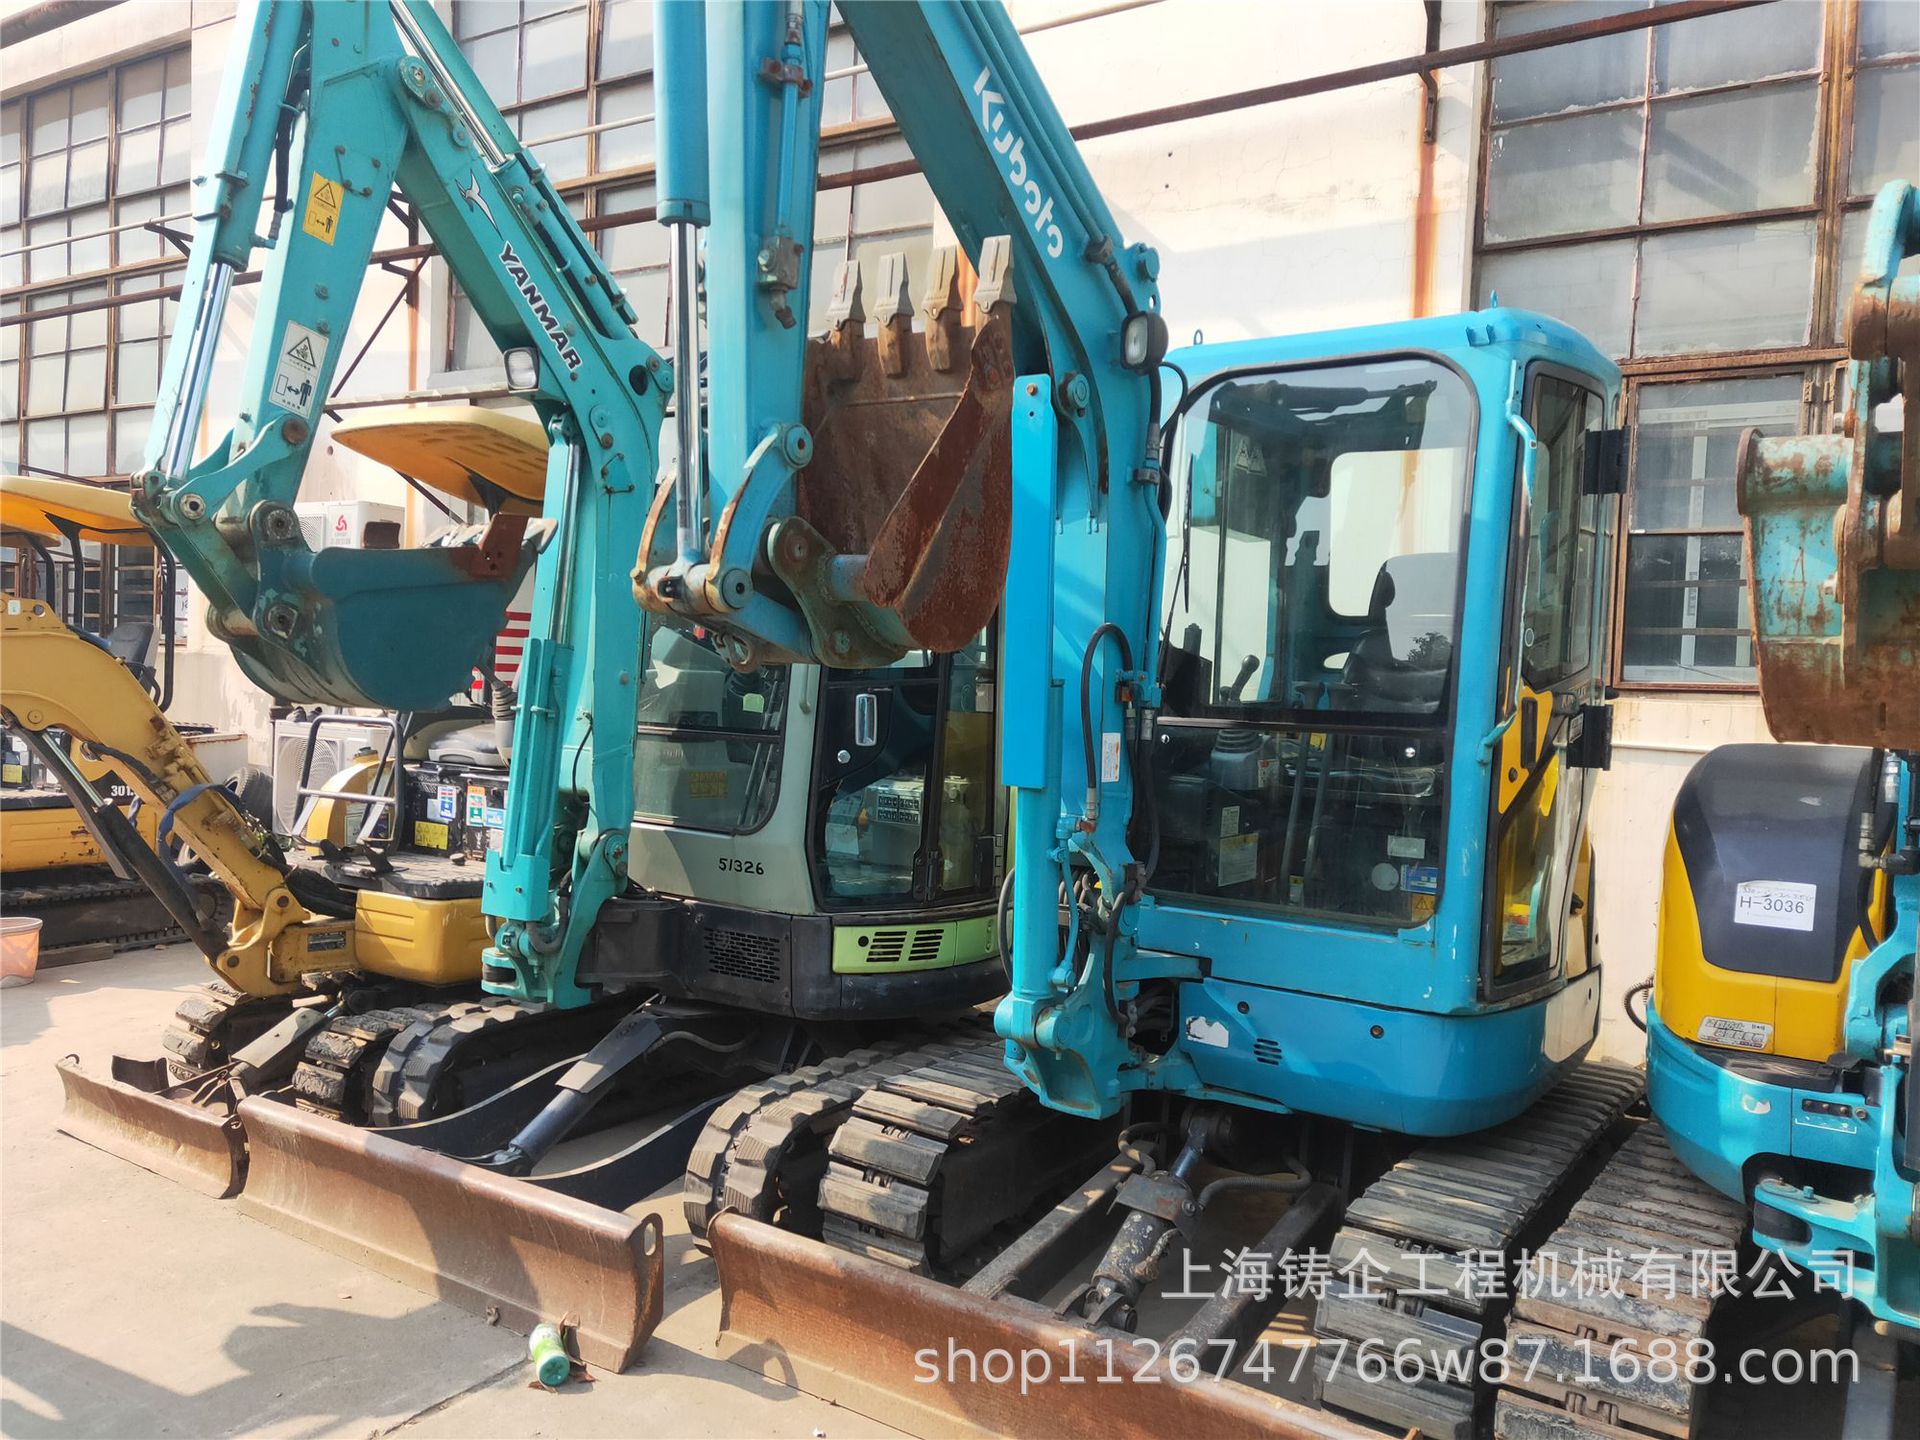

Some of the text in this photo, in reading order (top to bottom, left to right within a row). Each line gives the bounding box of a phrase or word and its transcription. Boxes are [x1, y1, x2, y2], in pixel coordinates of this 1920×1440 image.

[973, 66, 1063, 258] Kubota
[499, 240, 583, 371] YANMAR
[111, 785, 134, 797] 301.
[718, 857, 765, 875] 51326
[1740, 895, 1804, 914] H-3036
